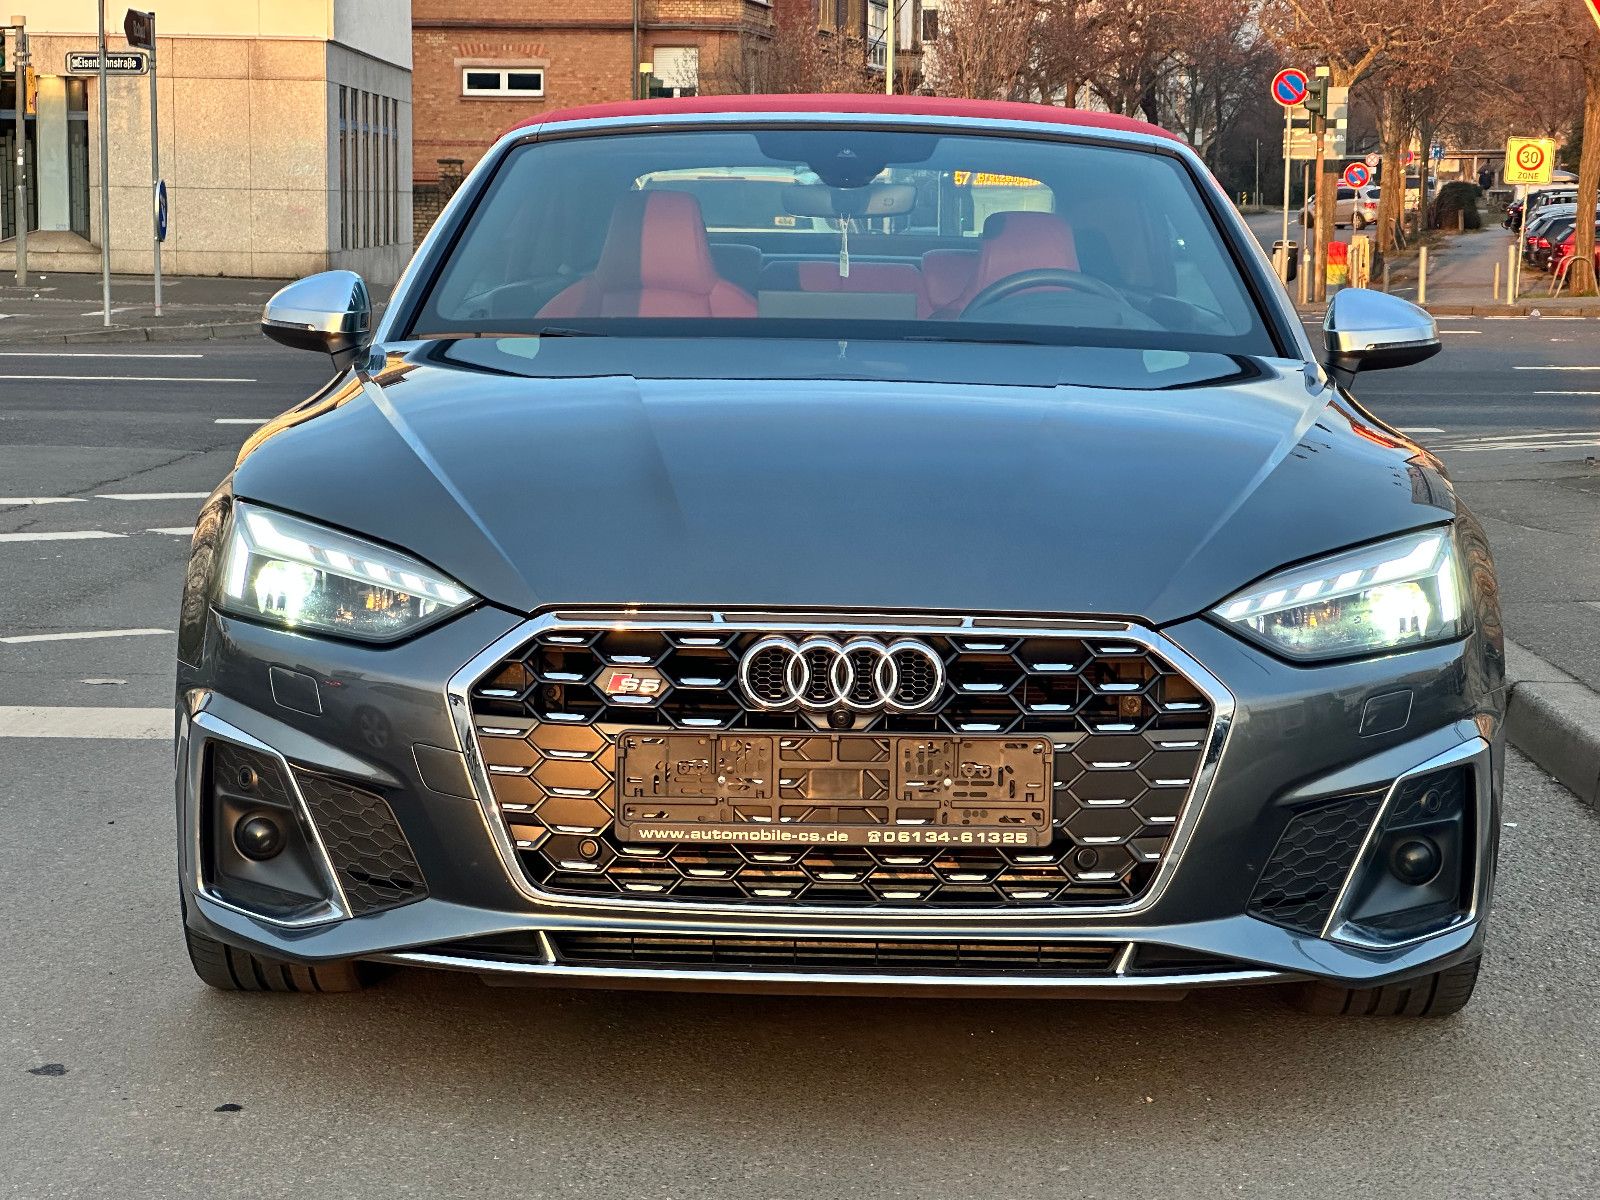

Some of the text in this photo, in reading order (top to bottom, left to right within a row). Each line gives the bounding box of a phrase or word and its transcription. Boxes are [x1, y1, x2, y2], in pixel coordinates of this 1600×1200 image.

[77, 57, 137, 69] Eisenbhnstraße
[1521, 151, 1539, 164] 30
[953, 170, 971, 185] 57
[1517, 171, 1540, 180] ZONE
[616, 676, 661, 693] S5
[638, 828, 849, 842] www.automobile-cs.de
